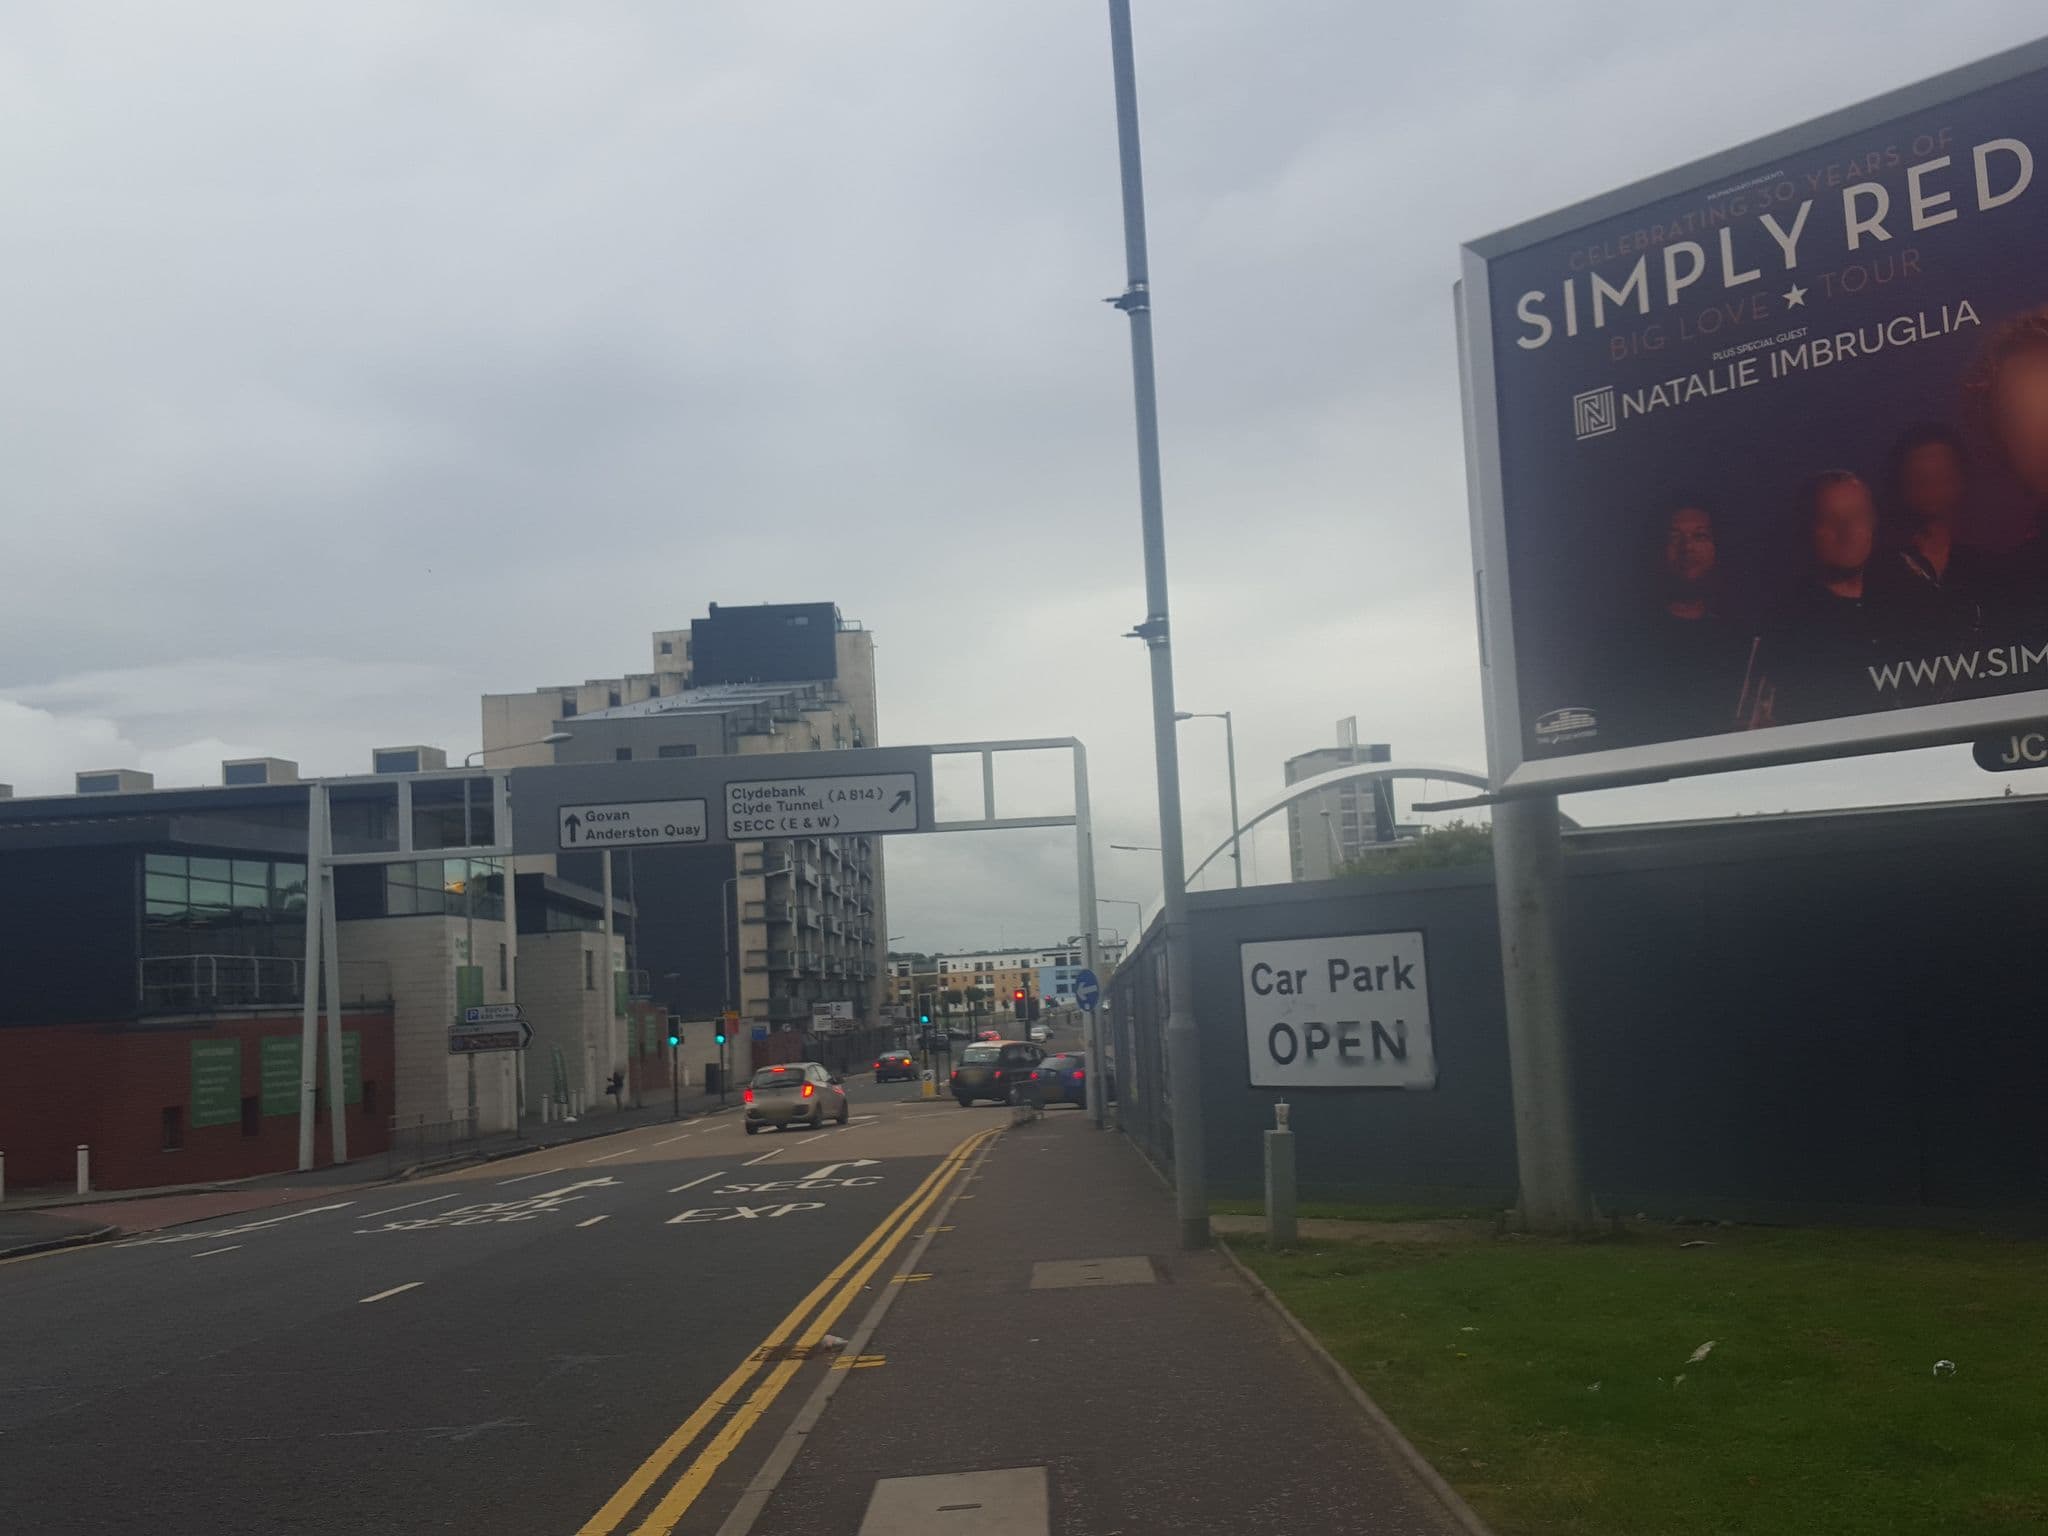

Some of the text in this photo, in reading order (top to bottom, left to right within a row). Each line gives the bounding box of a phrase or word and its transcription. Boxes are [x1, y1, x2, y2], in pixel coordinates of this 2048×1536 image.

[1569, 196, 1749, 270] CELEBRATING
[1758, 181, 1796, 210] 30
[1808, 145, 1901, 196] YEARS
[1912, 127, 1955, 159] OF
[1515, 137, 2034, 350] SIMPLY RED
[1608, 247, 1922, 362] BIG LOVE TOUR
[1712, 327, 1808, 361] PLUS SPECIAL GUEST
[1621, 299, 1982, 419] NATALIE IMBRUGLIA
[732, 785, 806, 800] Clydebank
[585, 810, 631, 823] Govan
[732, 800, 824, 816] Clyde Tunnel
[586, 824, 701, 840] Anderston Quay
[733, 819, 775, 832] SECC
[1251, 955, 1416, 996] Car Park
[1268, 1019, 1408, 1066] OPEN
[713, 1176, 886, 1194] SECC
[664, 1202, 827, 1224] EXP
